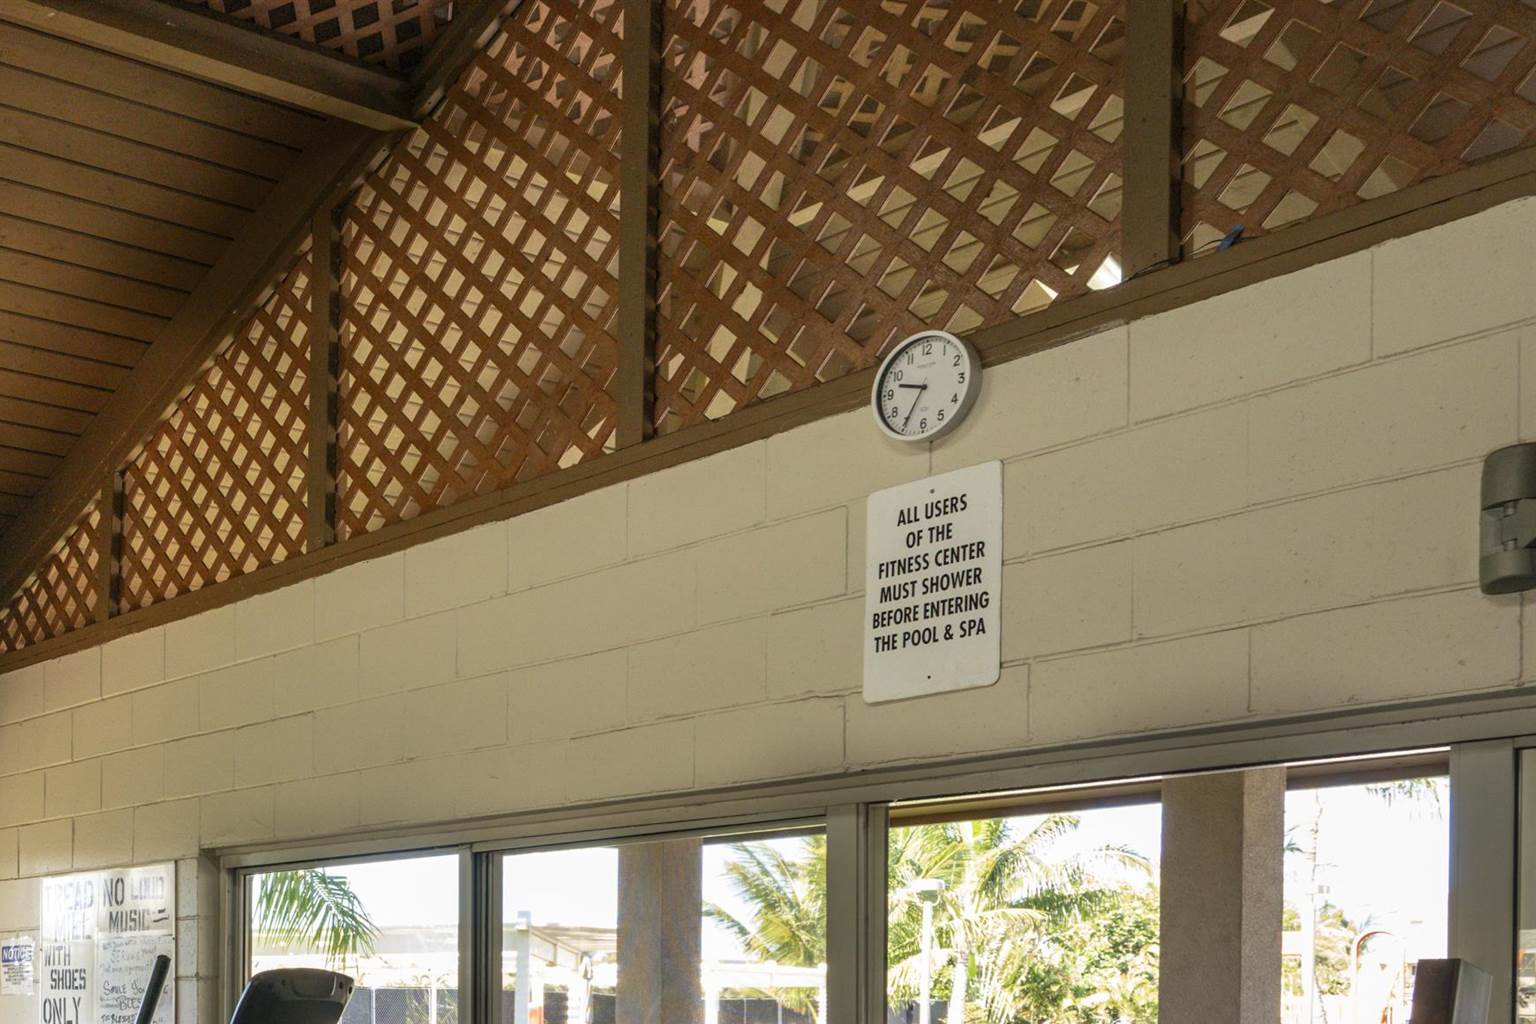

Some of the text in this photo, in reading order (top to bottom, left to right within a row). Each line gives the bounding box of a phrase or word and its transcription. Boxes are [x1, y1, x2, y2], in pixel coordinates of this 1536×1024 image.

[907, 353, 914, 366] 11
[922, 344, 933, 356] 12
[953, 354, 961, 367] 2
[893, 370, 903, 382] 10
[958, 372, 965, 384] 3
[887, 389, 894, 400] 9
[951, 393, 958, 405] 4
[891, 407, 898, 418] 8
[920, 418, 927, 429] 6
[937, 409, 945, 421] 5
[897, 493, 968, 526] ALL USERS
[905, 525, 953, 549] OF THE
[878, 541, 986, 580] FITNESS CENTER
[879, 567, 983, 604] MUST SHOWER
[872, 591, 990, 630] BEFORE ENTERING
[874, 617, 986, 653] THE POOL & SPA
[45, 880, 94, 913] TREAD
[103, 876, 164, 907] NO LOUD
[108, 908, 150, 933] MUSIC
[43, 945, 71, 967] WITH
[50, 968, 86, 990] SHOES
